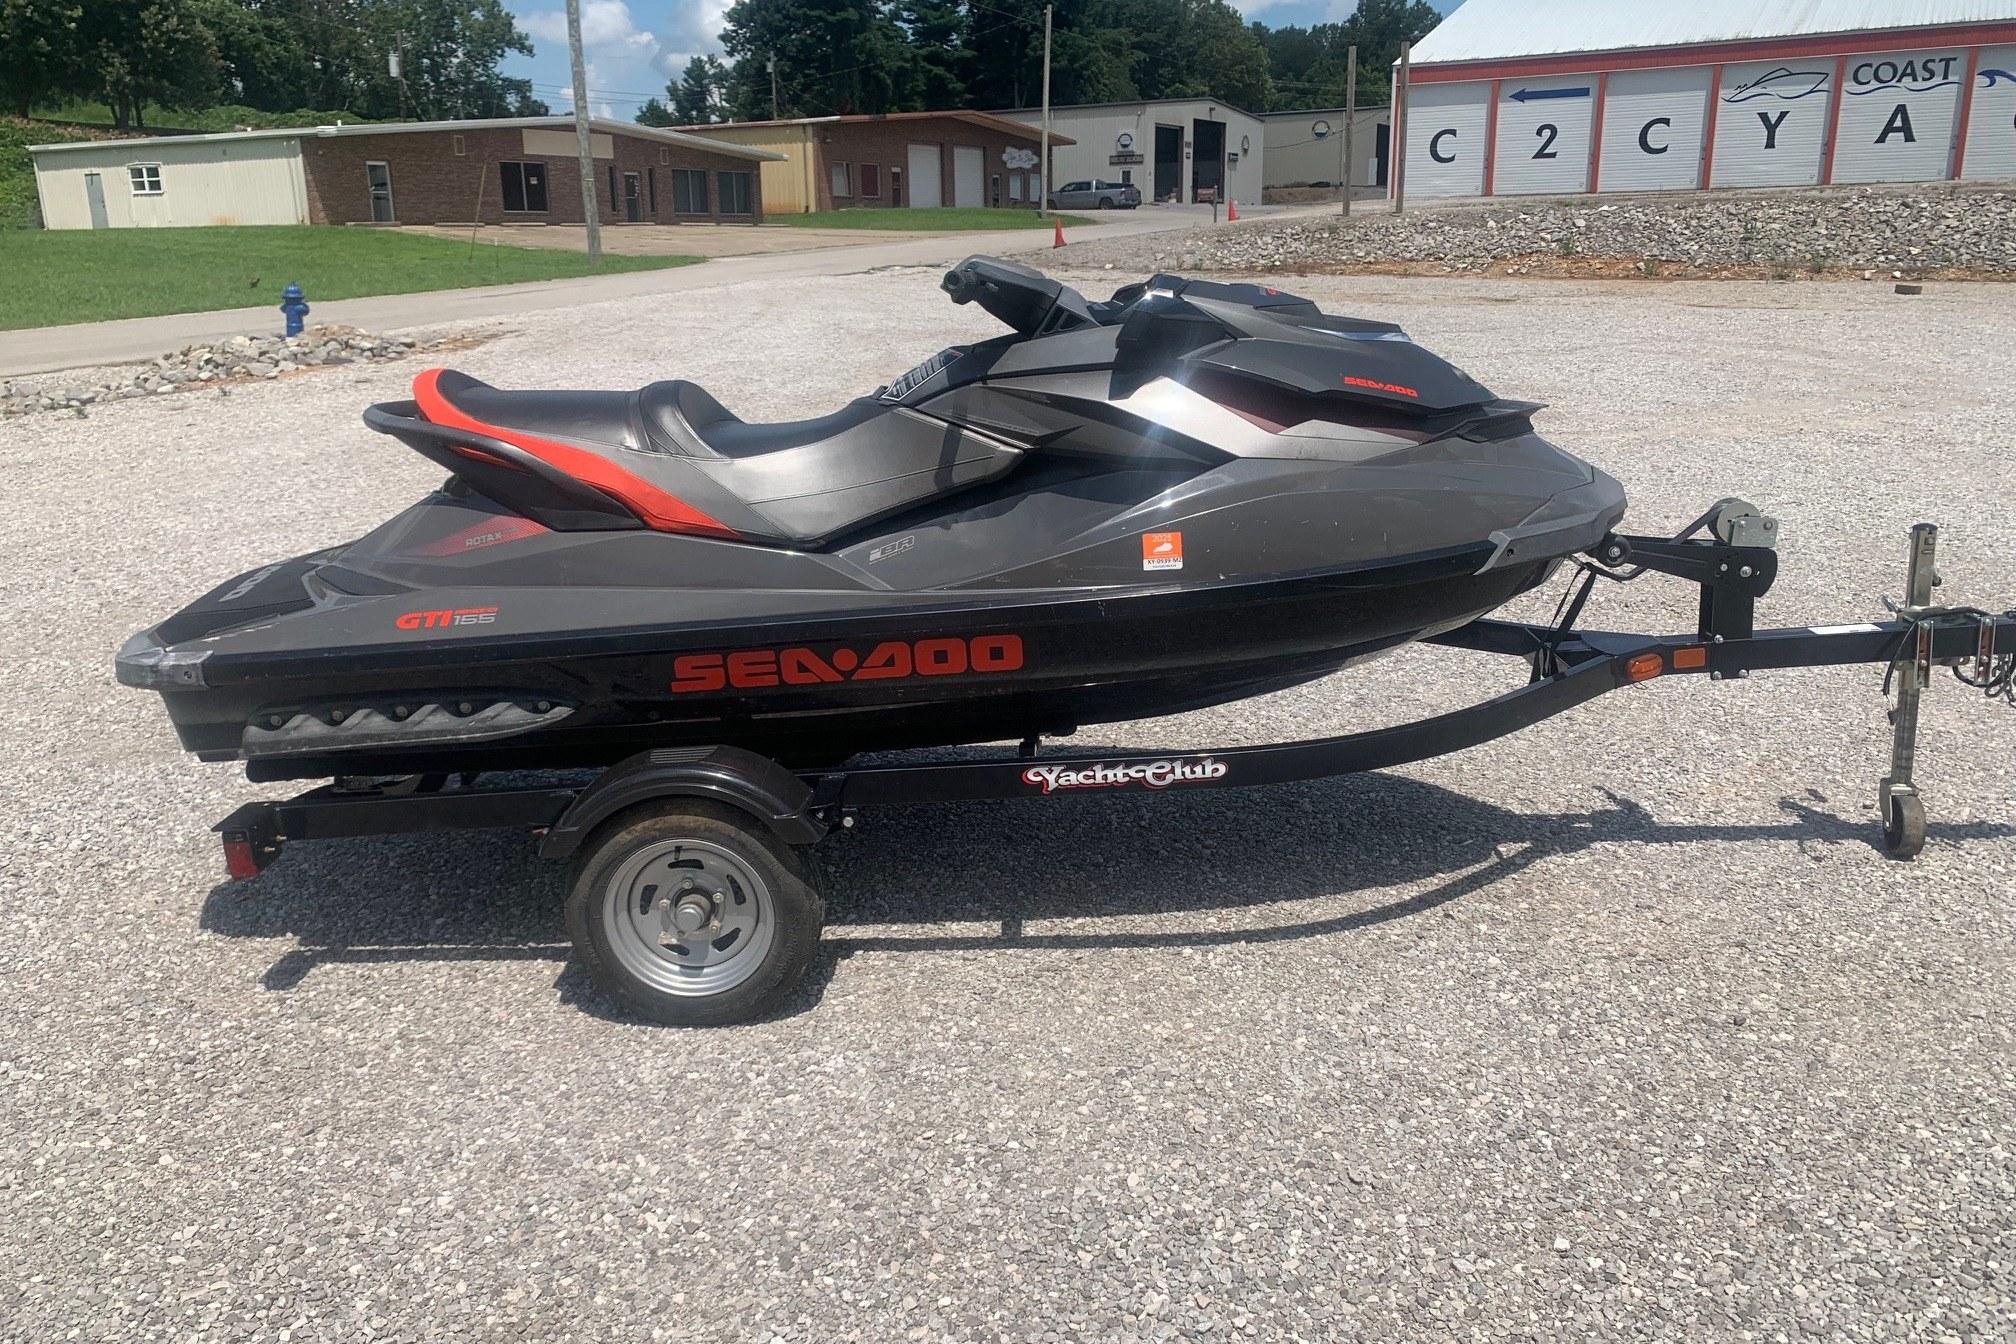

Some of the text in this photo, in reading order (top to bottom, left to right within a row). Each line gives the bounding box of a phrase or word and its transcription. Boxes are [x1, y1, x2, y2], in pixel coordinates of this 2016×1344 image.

[1852, 57, 1958, 86] COAST
[396, 610, 453, 629] GTI
[453, 613, 497, 626] 155
